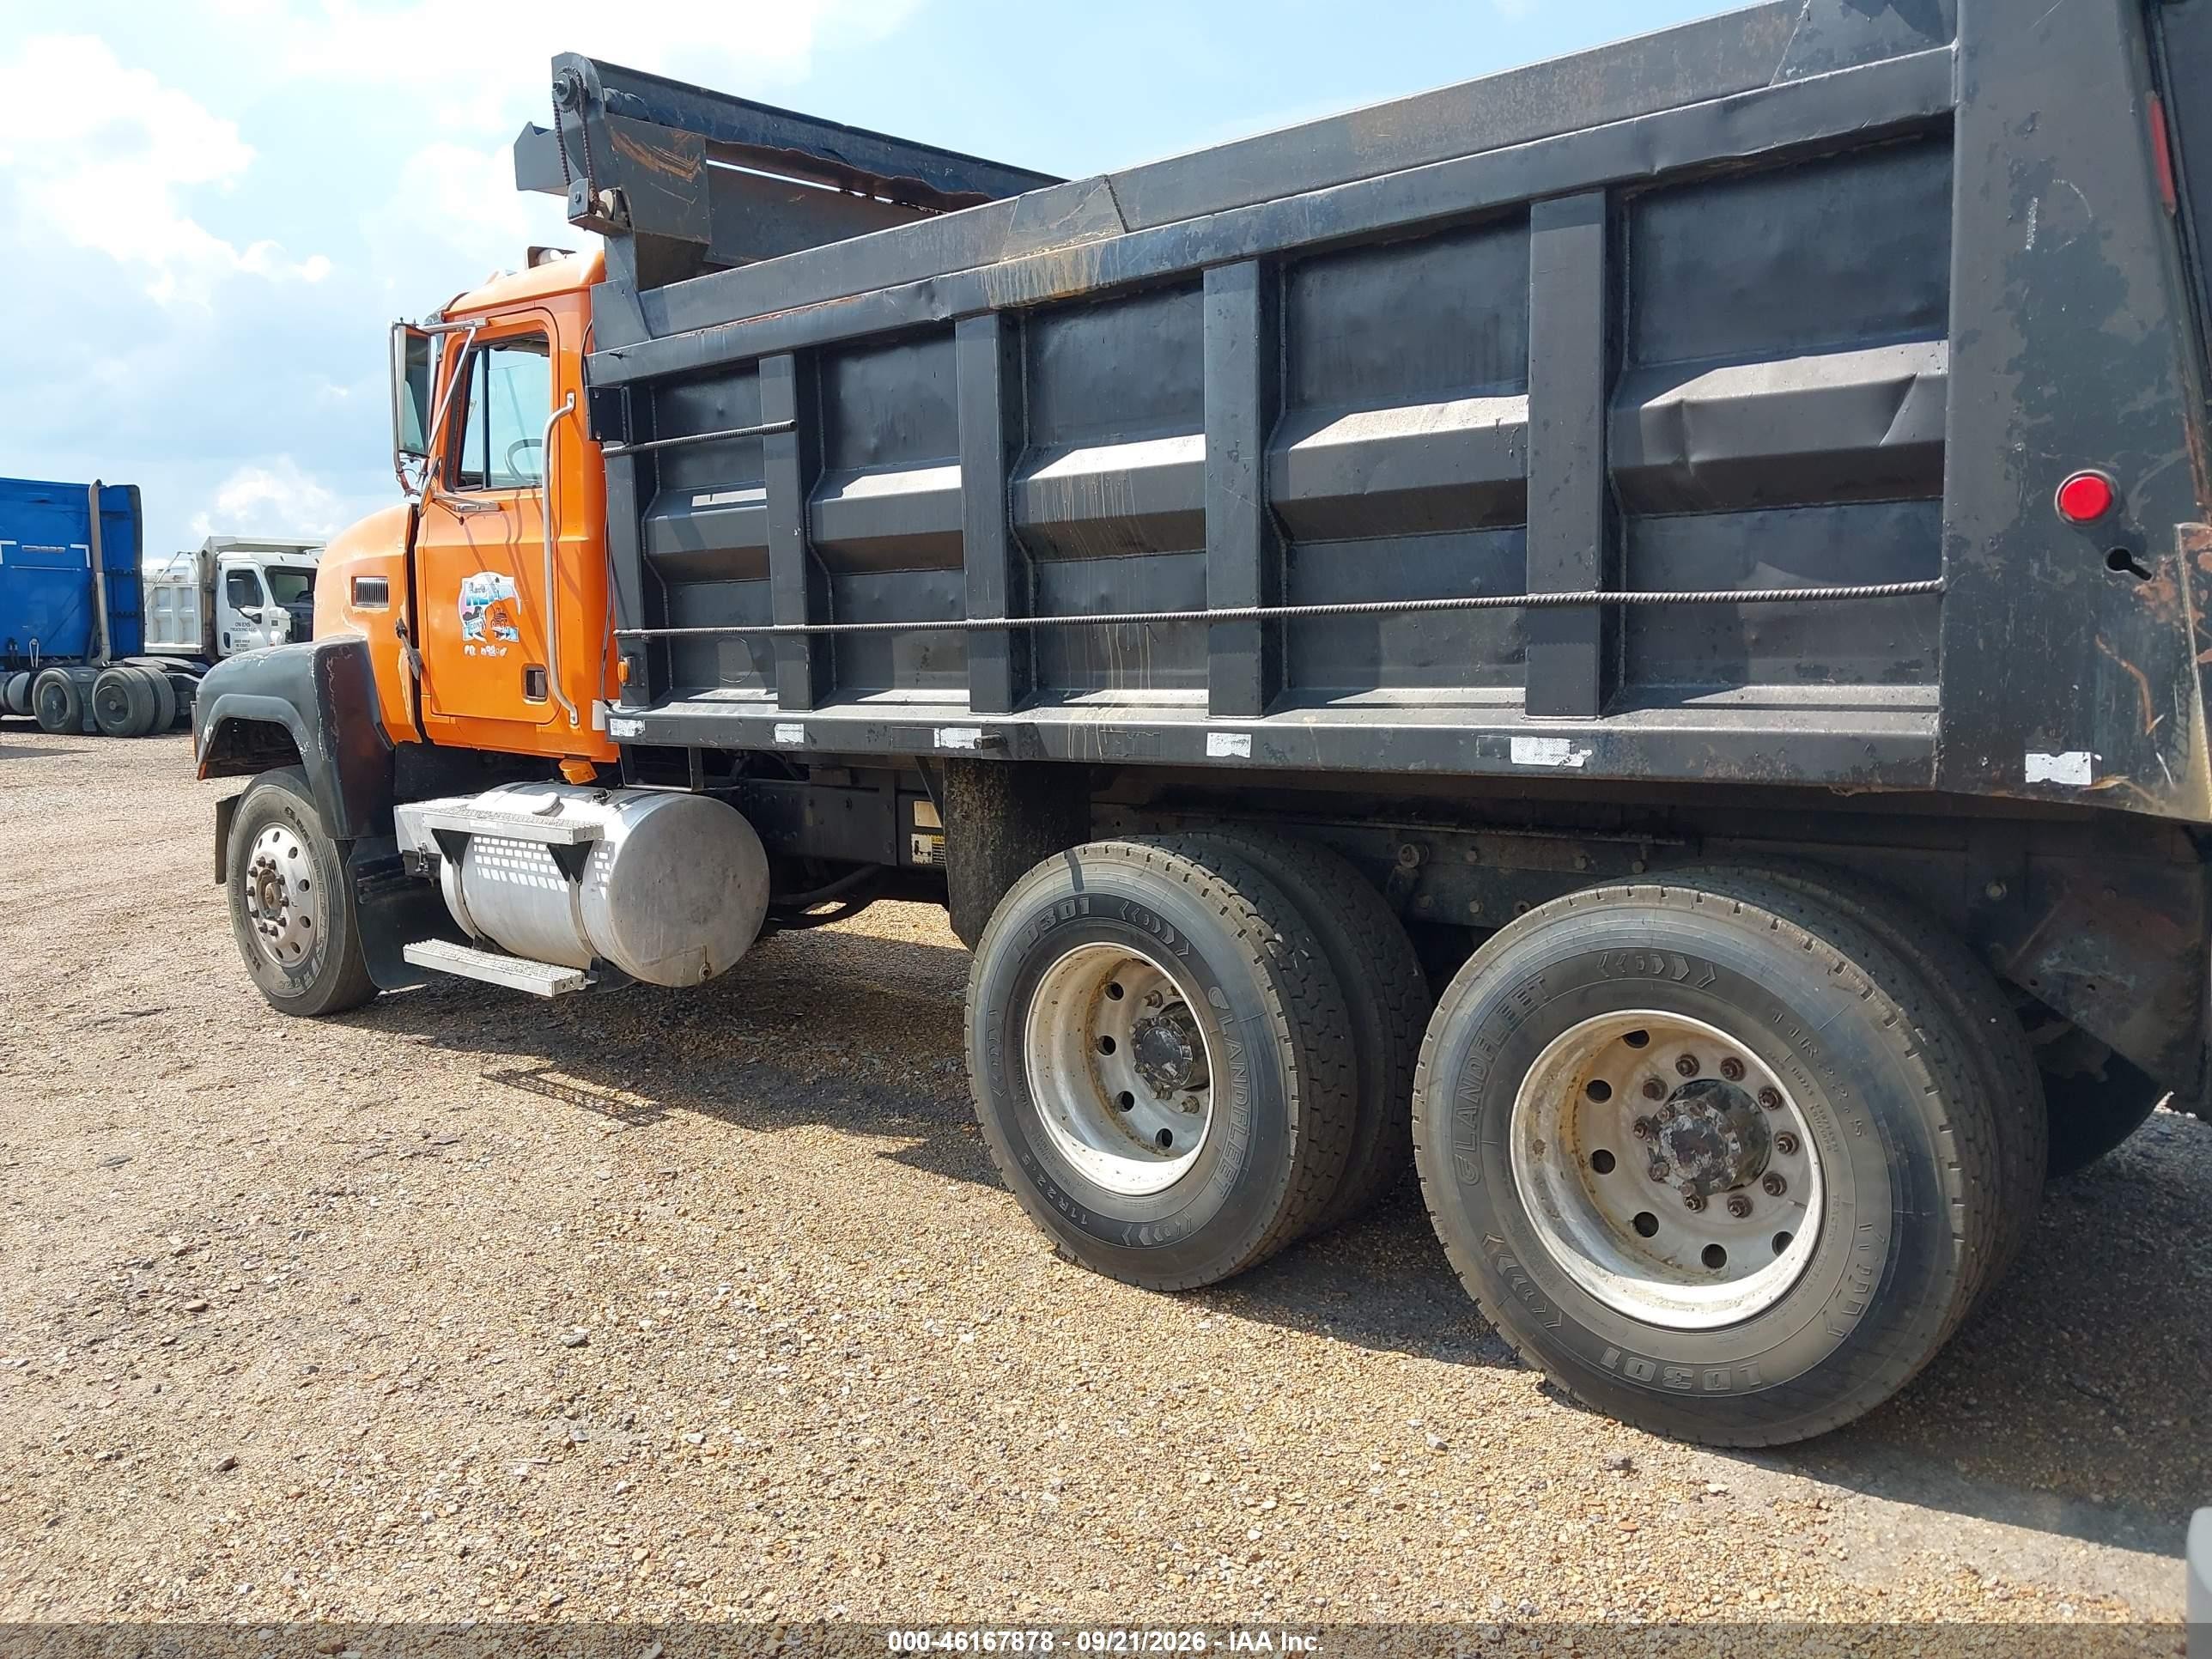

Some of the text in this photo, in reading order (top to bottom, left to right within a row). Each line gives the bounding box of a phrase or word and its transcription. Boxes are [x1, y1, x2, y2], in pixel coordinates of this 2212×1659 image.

[1012, 896, 1090, 963] LD301
[1022, 1152, 1087, 1224] 11R22.5
[1600, 1346, 1763, 1391] LD301
